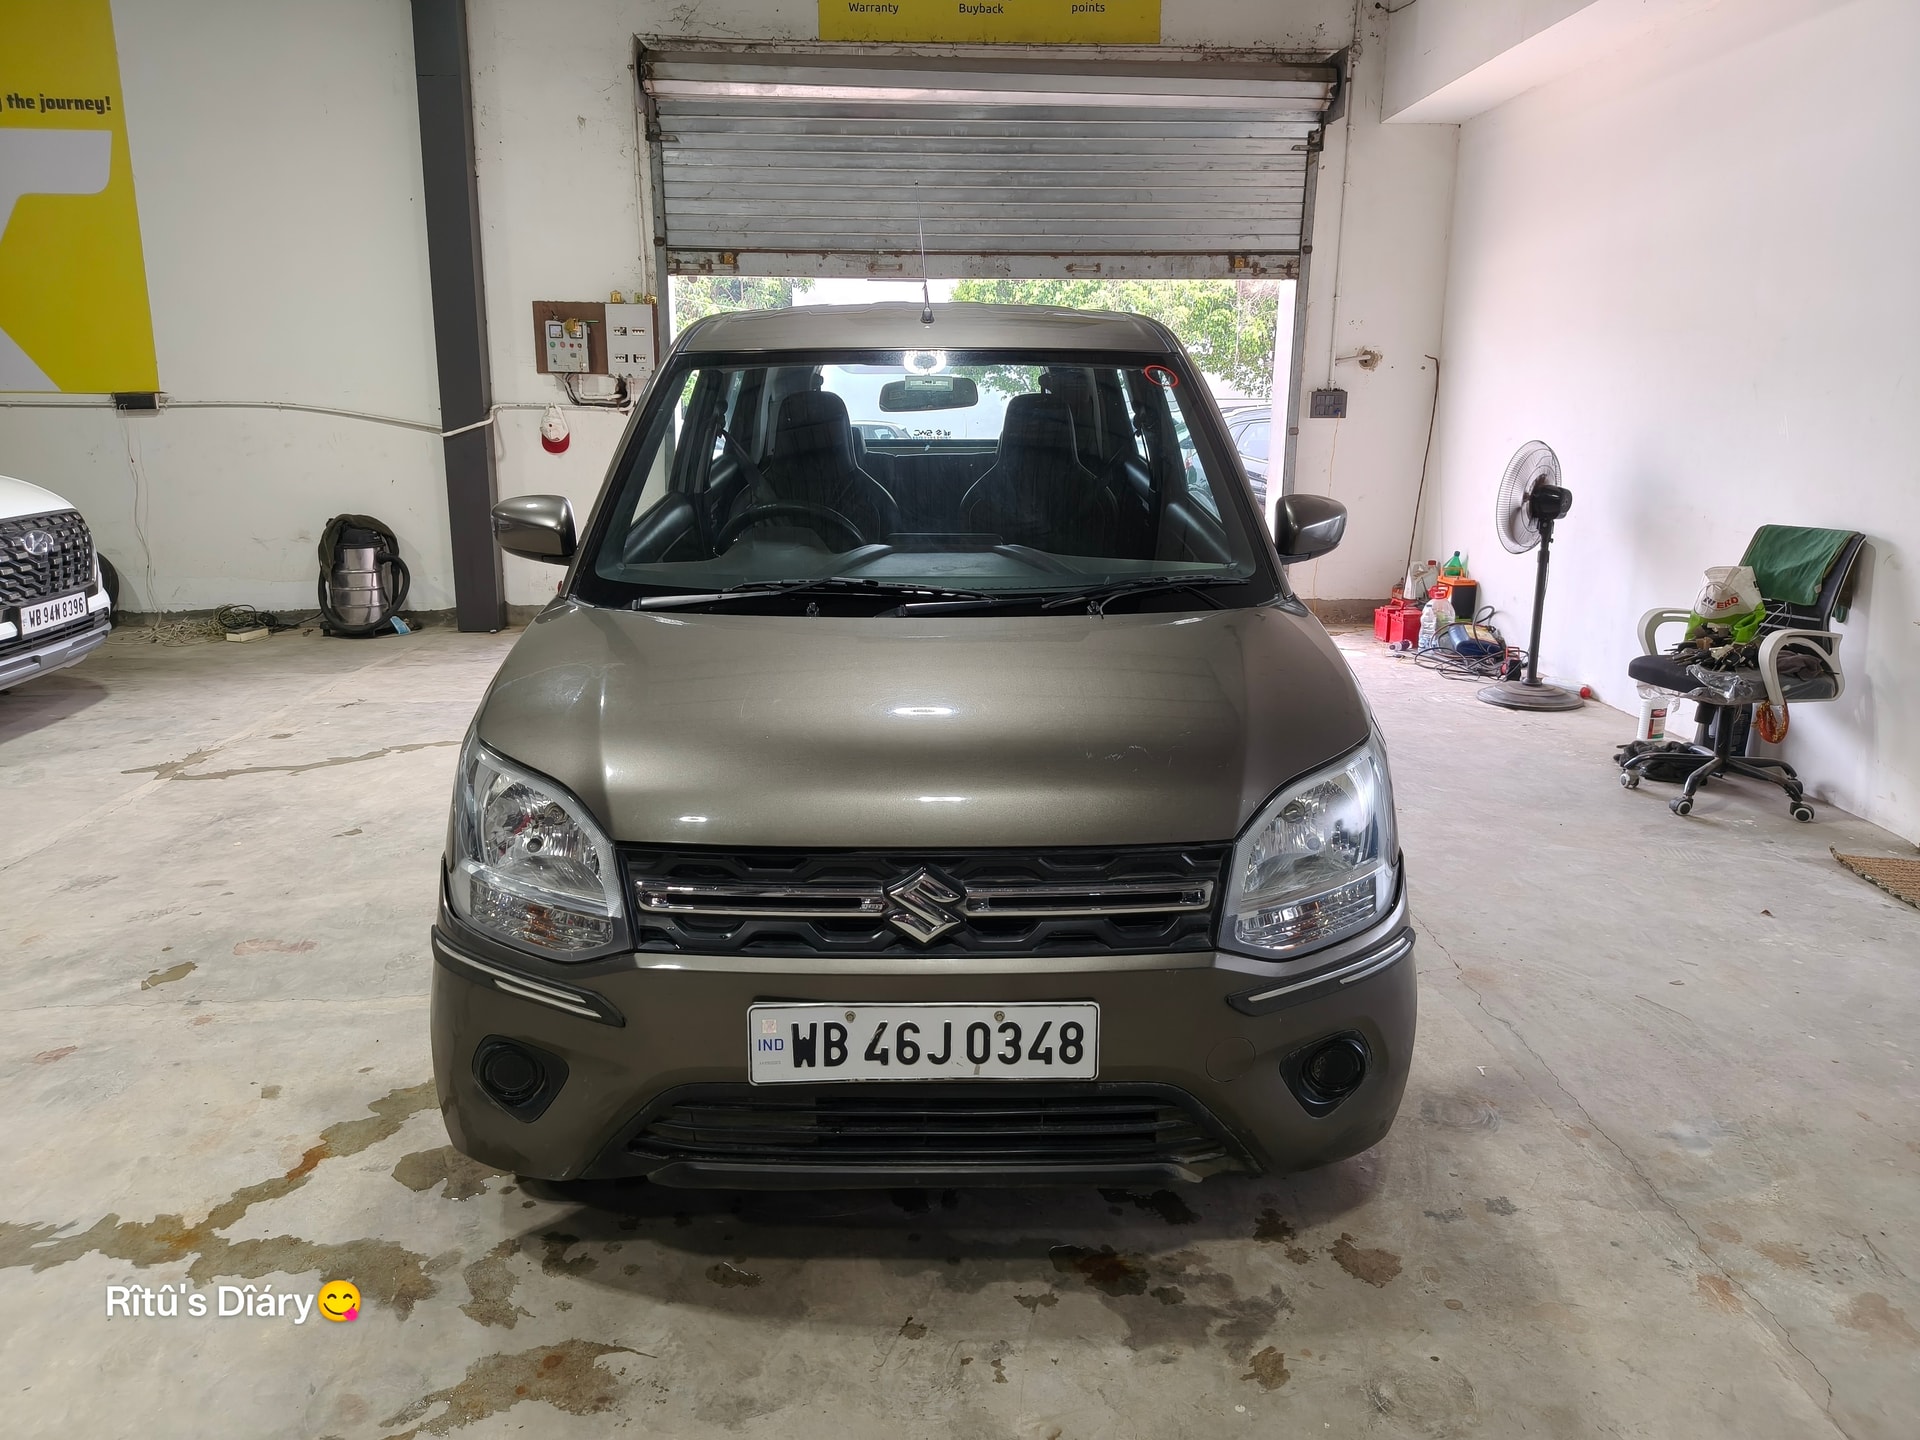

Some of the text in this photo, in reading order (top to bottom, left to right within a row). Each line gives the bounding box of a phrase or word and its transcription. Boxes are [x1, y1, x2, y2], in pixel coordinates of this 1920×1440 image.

[848, 2, 899, 15] Warranty
[958, 2, 1004, 15] Buyback
[1071, 1, 1105, 14] points
[6, 92, 36, 109] the
[39, 93, 112, 114] journey!
[28, 597, 84, 628] WB 94N 8396
[757, 1038, 784, 1052] IND
[791, 1021, 849, 1068] WB
